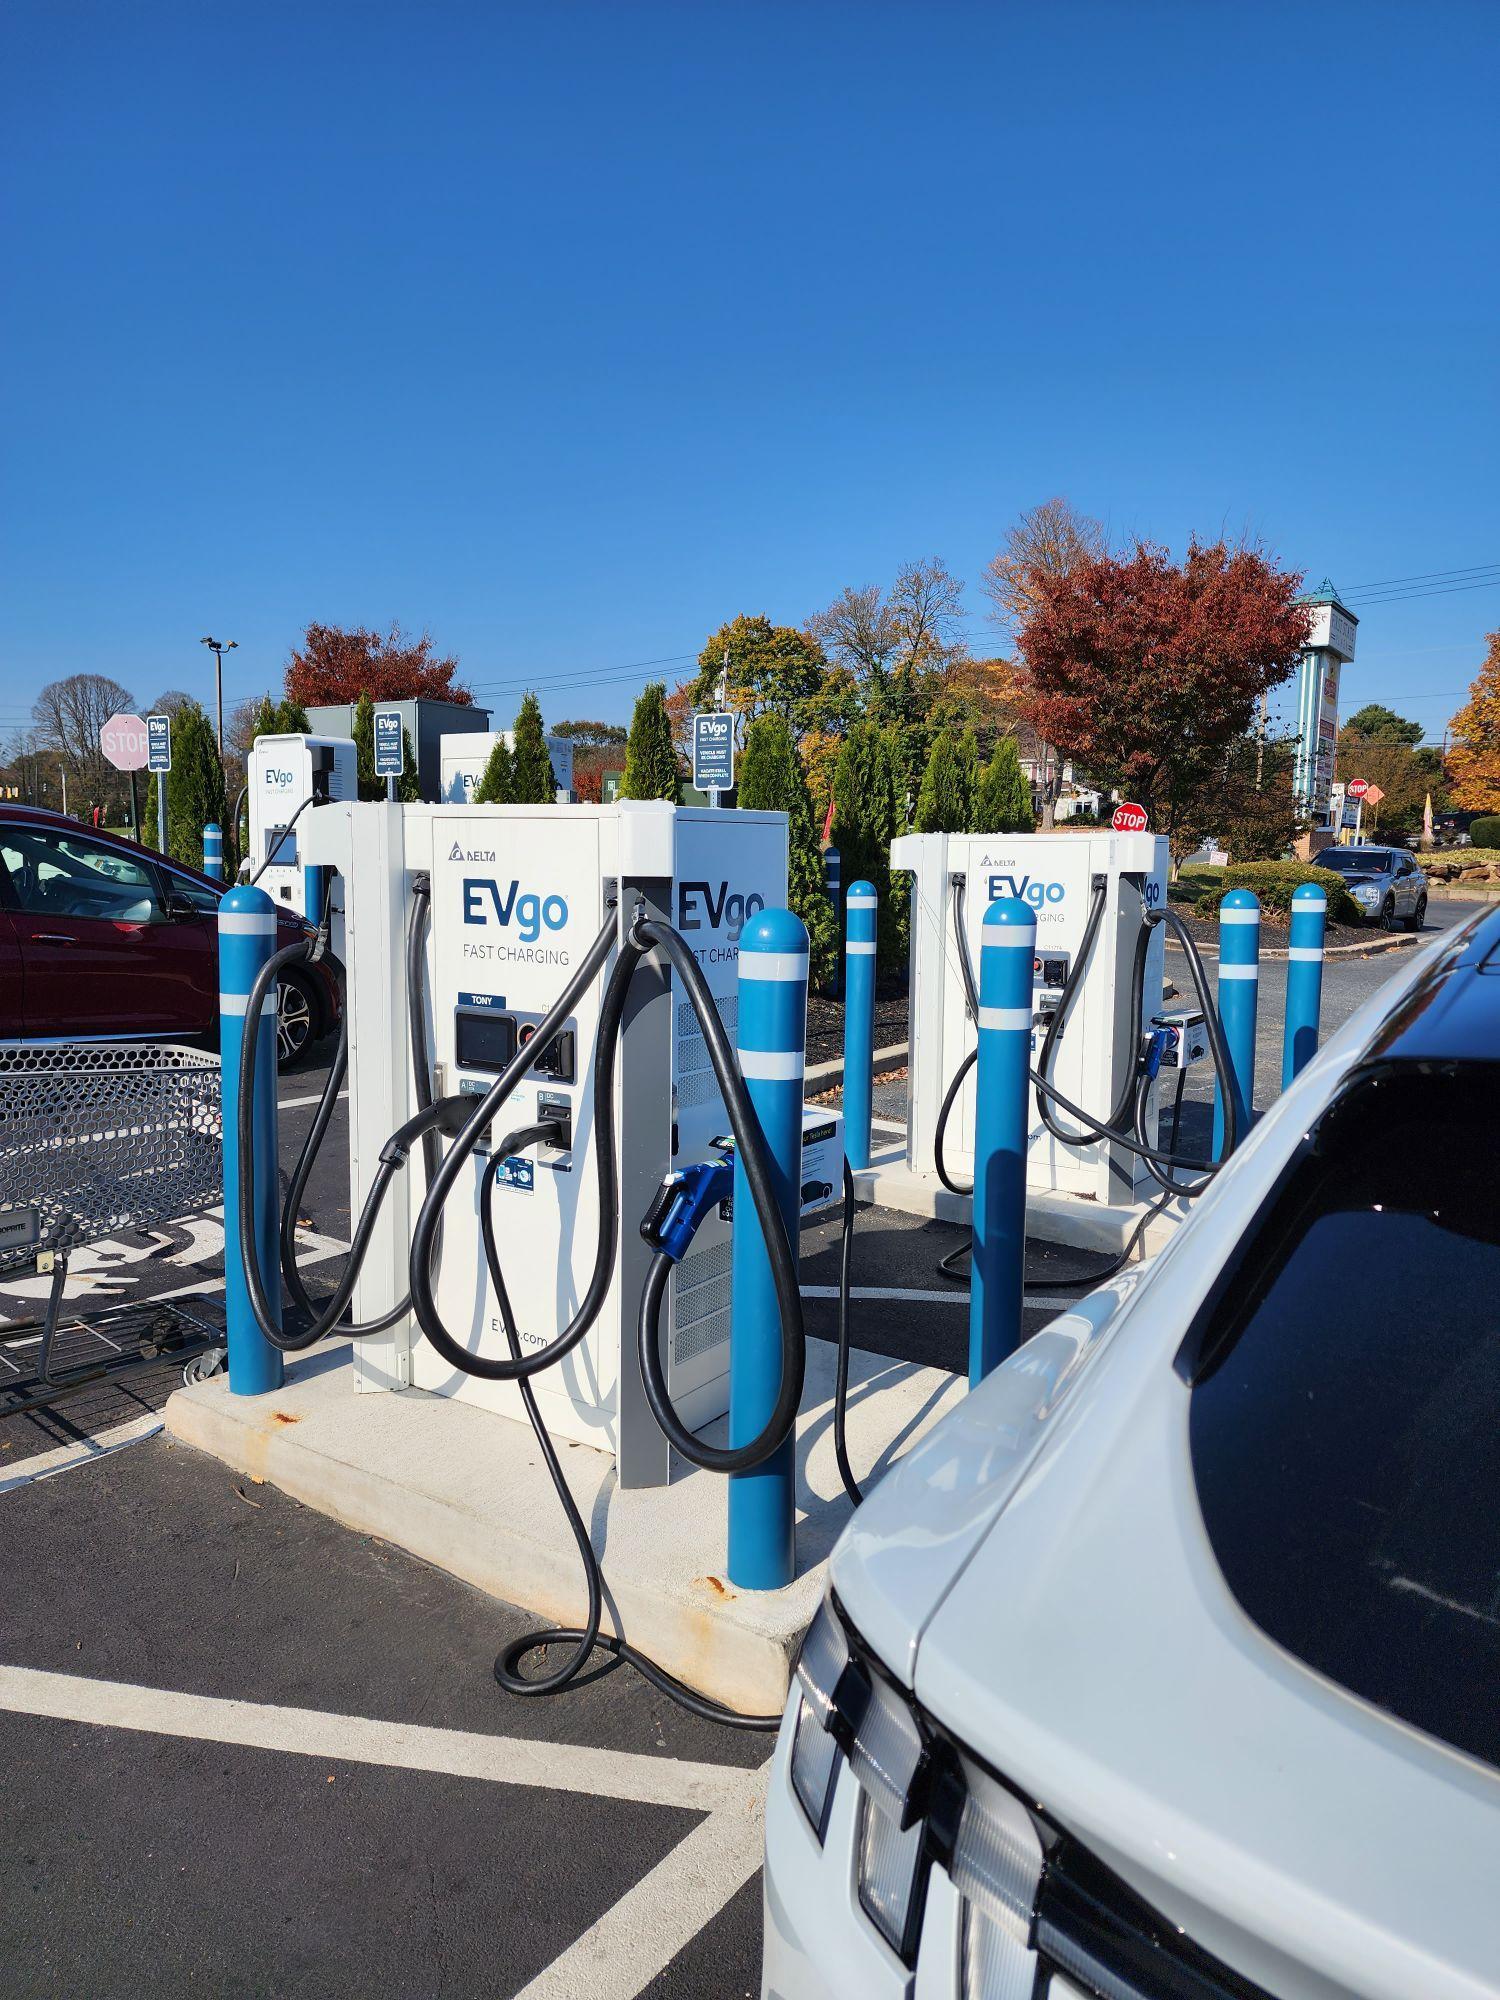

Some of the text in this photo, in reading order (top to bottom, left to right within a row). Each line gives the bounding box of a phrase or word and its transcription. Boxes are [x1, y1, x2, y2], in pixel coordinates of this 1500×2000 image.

[150, 721, 166, 732] EVgo
[378, 718, 399, 730] EVgo
[700, 722, 727, 736] EVgo
[266, 769, 293, 787] EVgo
[1349, 784, 1367, 793] STOP
[1114, 811, 1146, 828] STOP
[467, 850, 496, 862] DELTA
[988, 875, 1066, 911] EVgo
[463, 878, 569, 942] EVgo
[463, 943, 569, 966] FAST CHARGING
[709, 947, 739, 963] CHAR
[471, 995, 493, 1006] TONY
[538, 1093, 543, 1101] B
[0, 1222, 26, 1233] OPRITE
[492, 1318, 548, 1347] EV.com
